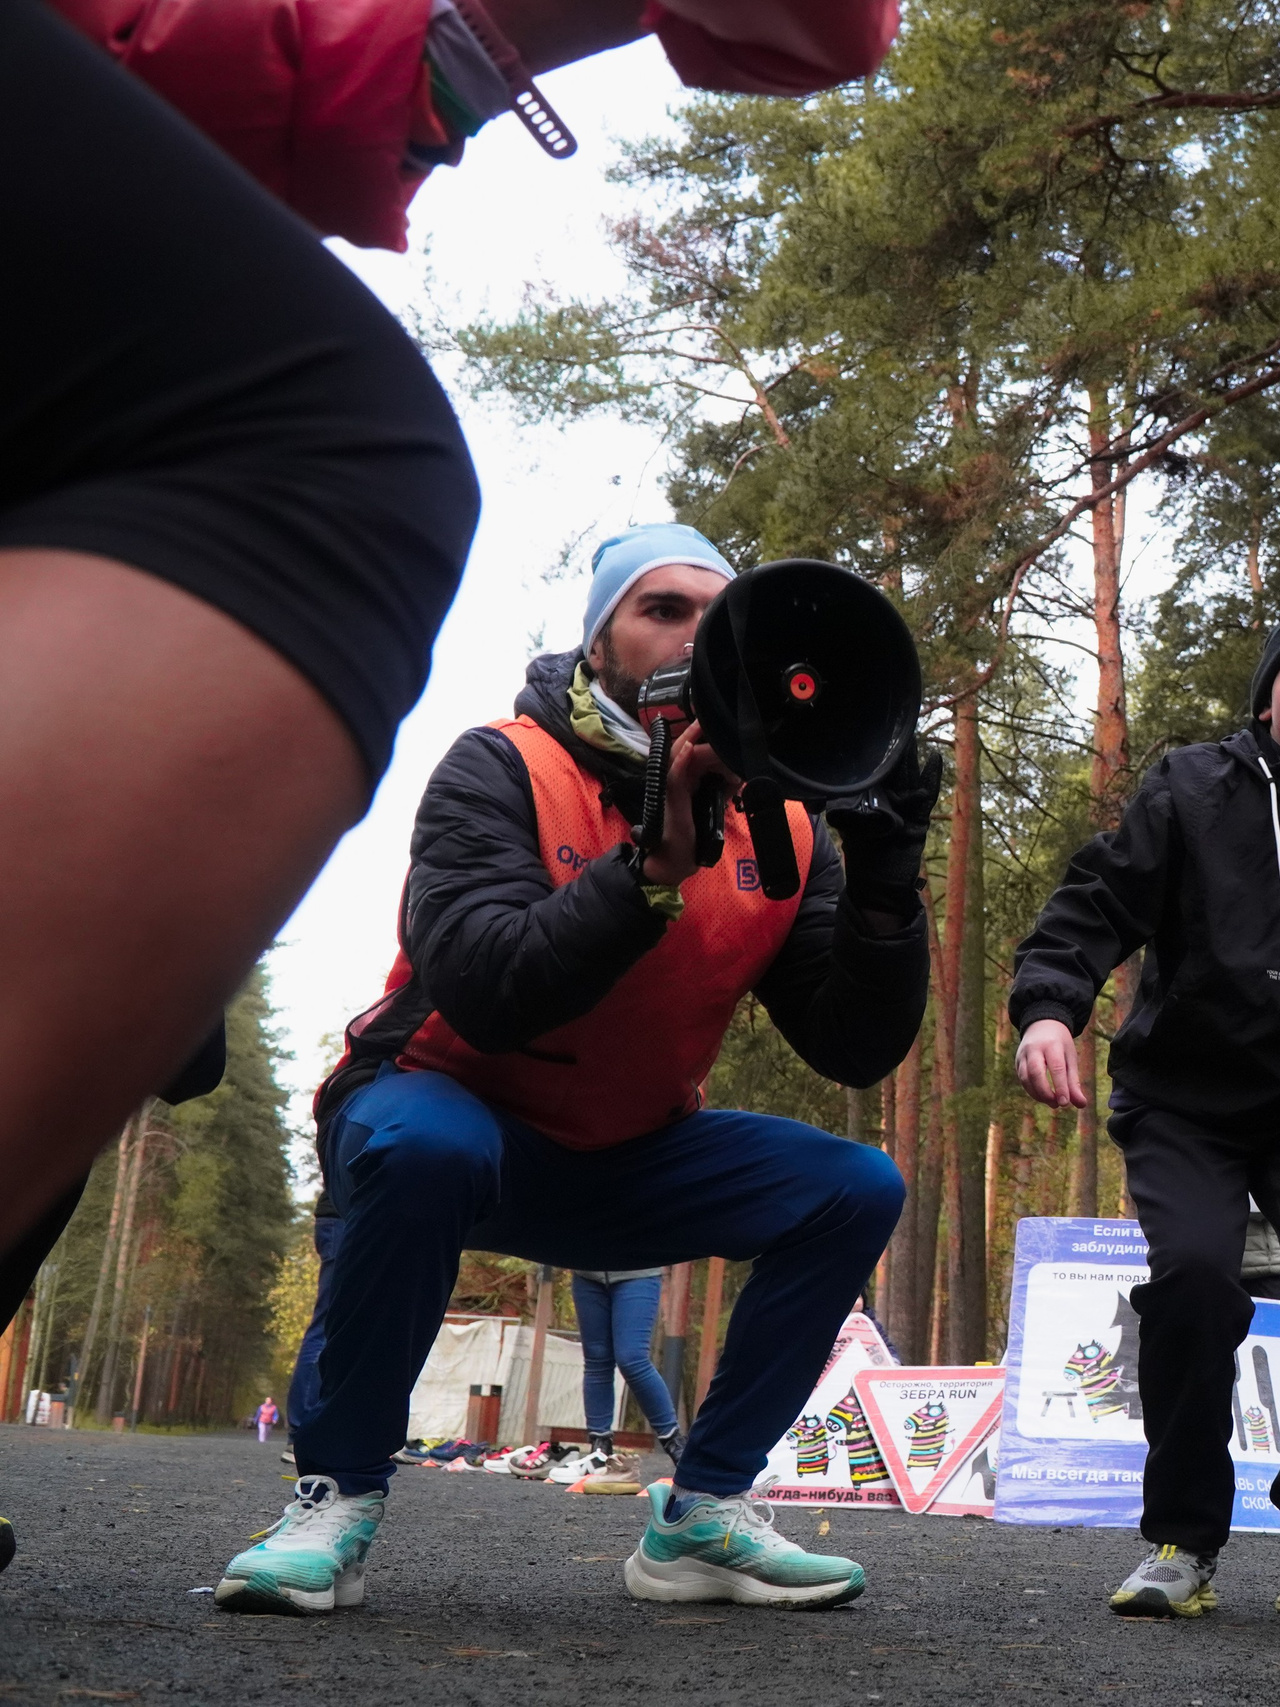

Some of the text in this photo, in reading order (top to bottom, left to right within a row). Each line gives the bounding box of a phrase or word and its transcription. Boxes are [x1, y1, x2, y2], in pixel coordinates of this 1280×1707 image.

[1093, 1224, 1130, 1238] Если
[1053, 1272, 1067, 1281] то
[1069, 1272, 1087, 1281] вы
[1090, 1273, 1114, 1282] нам
[880, 1380, 993, 1389] Осторожно, территория
[900, 1389, 977, 1400] ЗЕБРА RUN
[1011, 1464, 1044, 1480] Мы
[1046, 1469, 1109, 1484] всегда
[763, 1488, 863, 1503] огда-нибудь
[1242, 1495, 1277, 1511] СКОР
